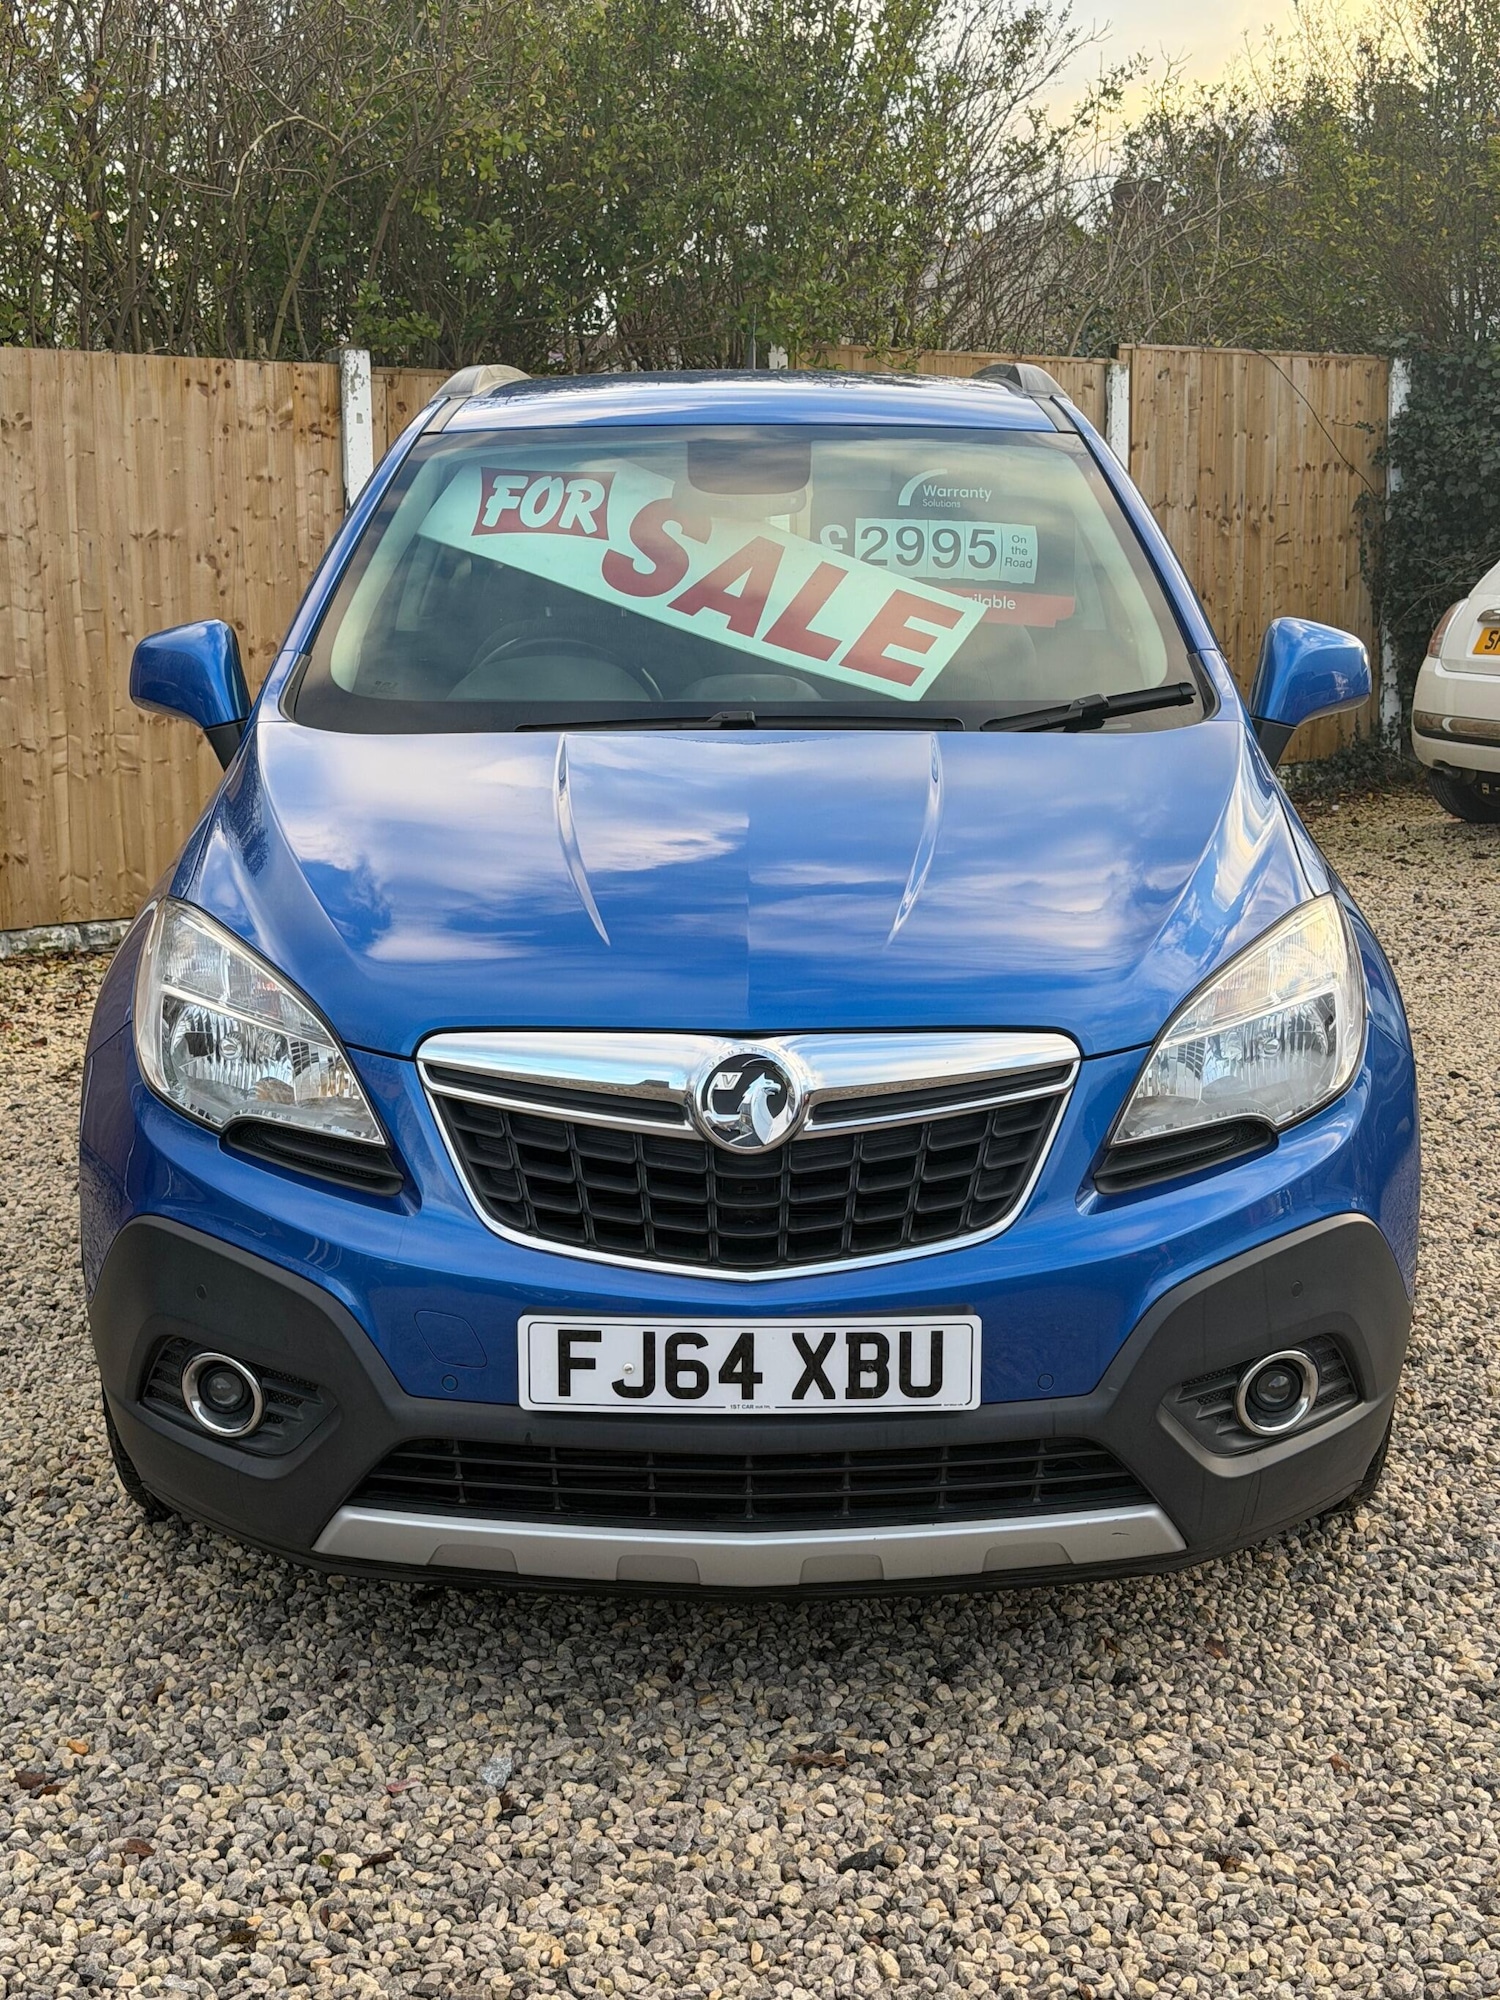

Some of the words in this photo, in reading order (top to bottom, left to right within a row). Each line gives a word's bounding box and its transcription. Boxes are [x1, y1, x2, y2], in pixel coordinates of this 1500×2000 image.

[922, 484, 992, 502] Warranty
[481, 474, 606, 535] FOR
[922, 499, 961, 509] Solutions
[1011, 534, 1027, 544] On
[1011, 546, 1028, 556] the
[1004, 557, 1033, 569] Road
[601, 498, 966, 688] SALE
[557, 1329, 763, 1400] FJ64
[791, 1330, 944, 1400] XBU
